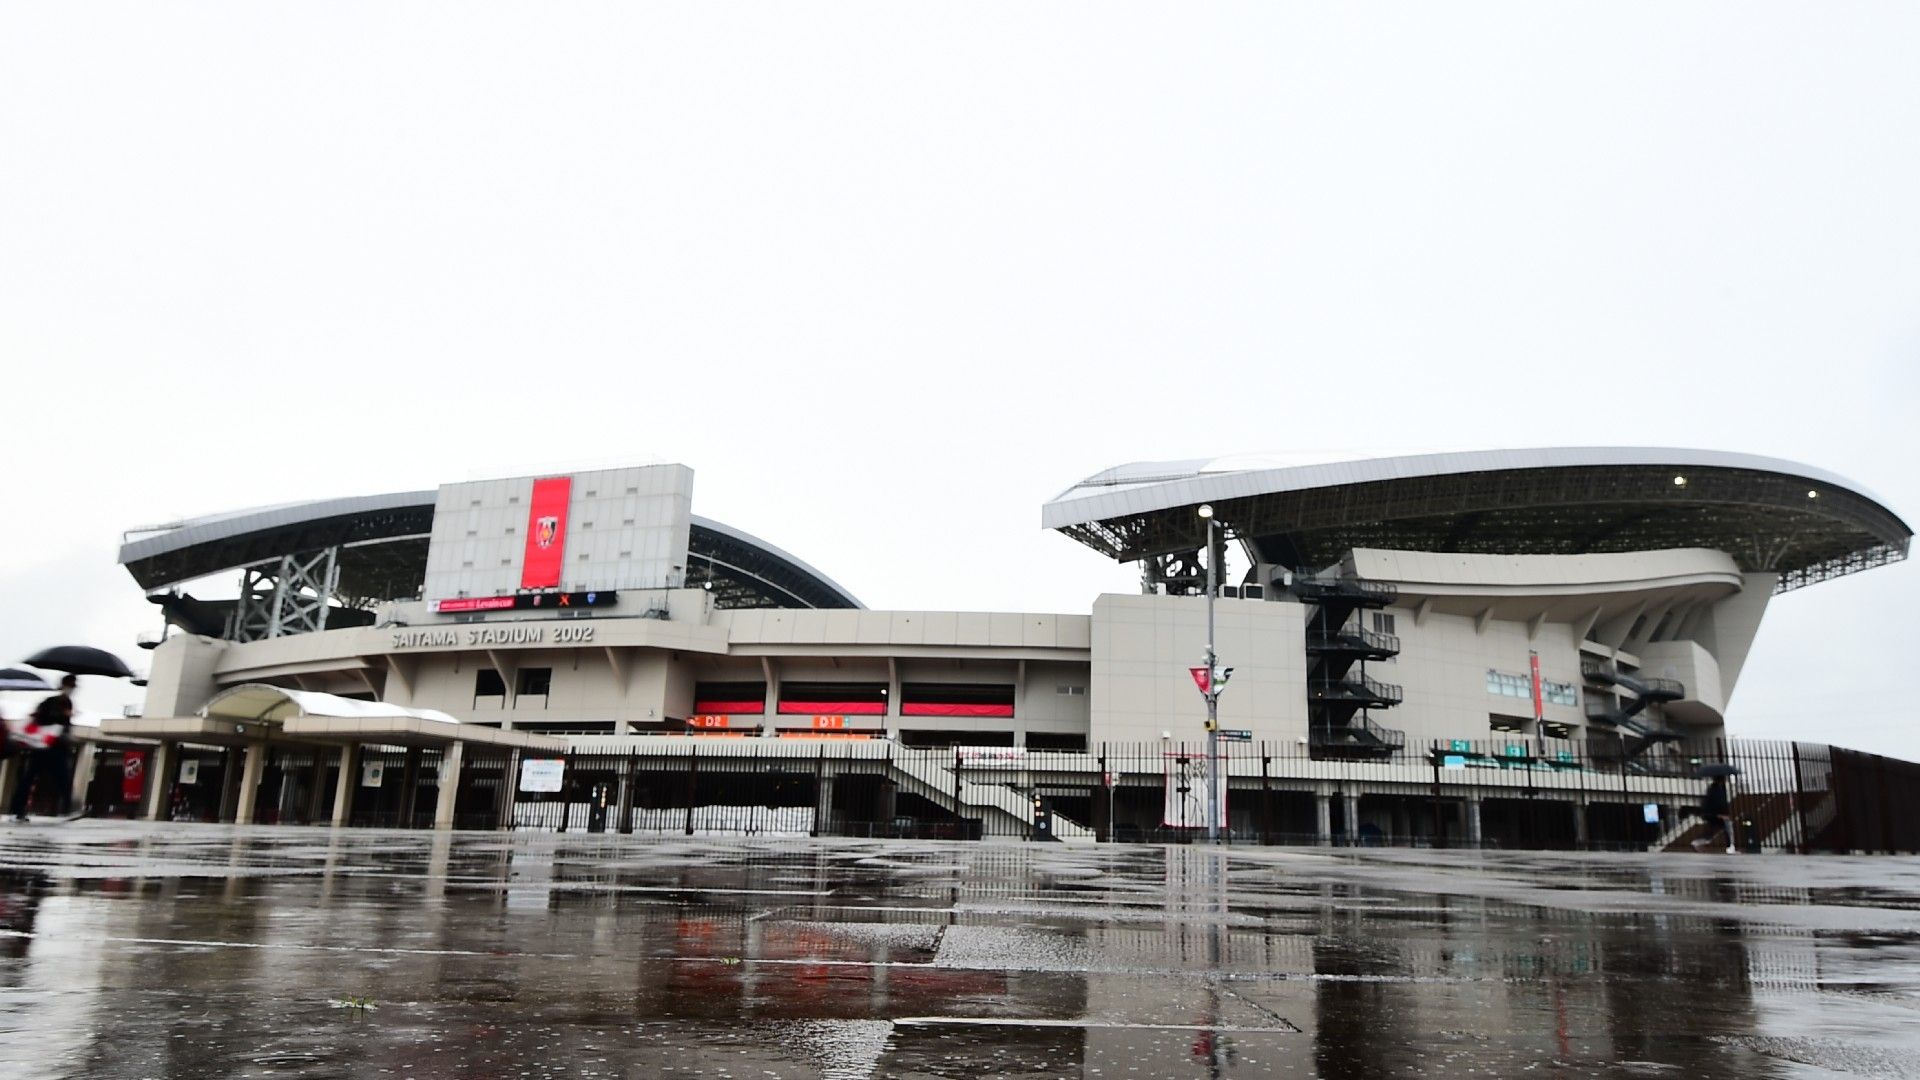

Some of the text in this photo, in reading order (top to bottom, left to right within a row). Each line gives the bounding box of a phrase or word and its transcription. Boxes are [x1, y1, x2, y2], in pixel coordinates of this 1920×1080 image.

[391, 625, 595, 649] SAITAMA STADIUM 2002
